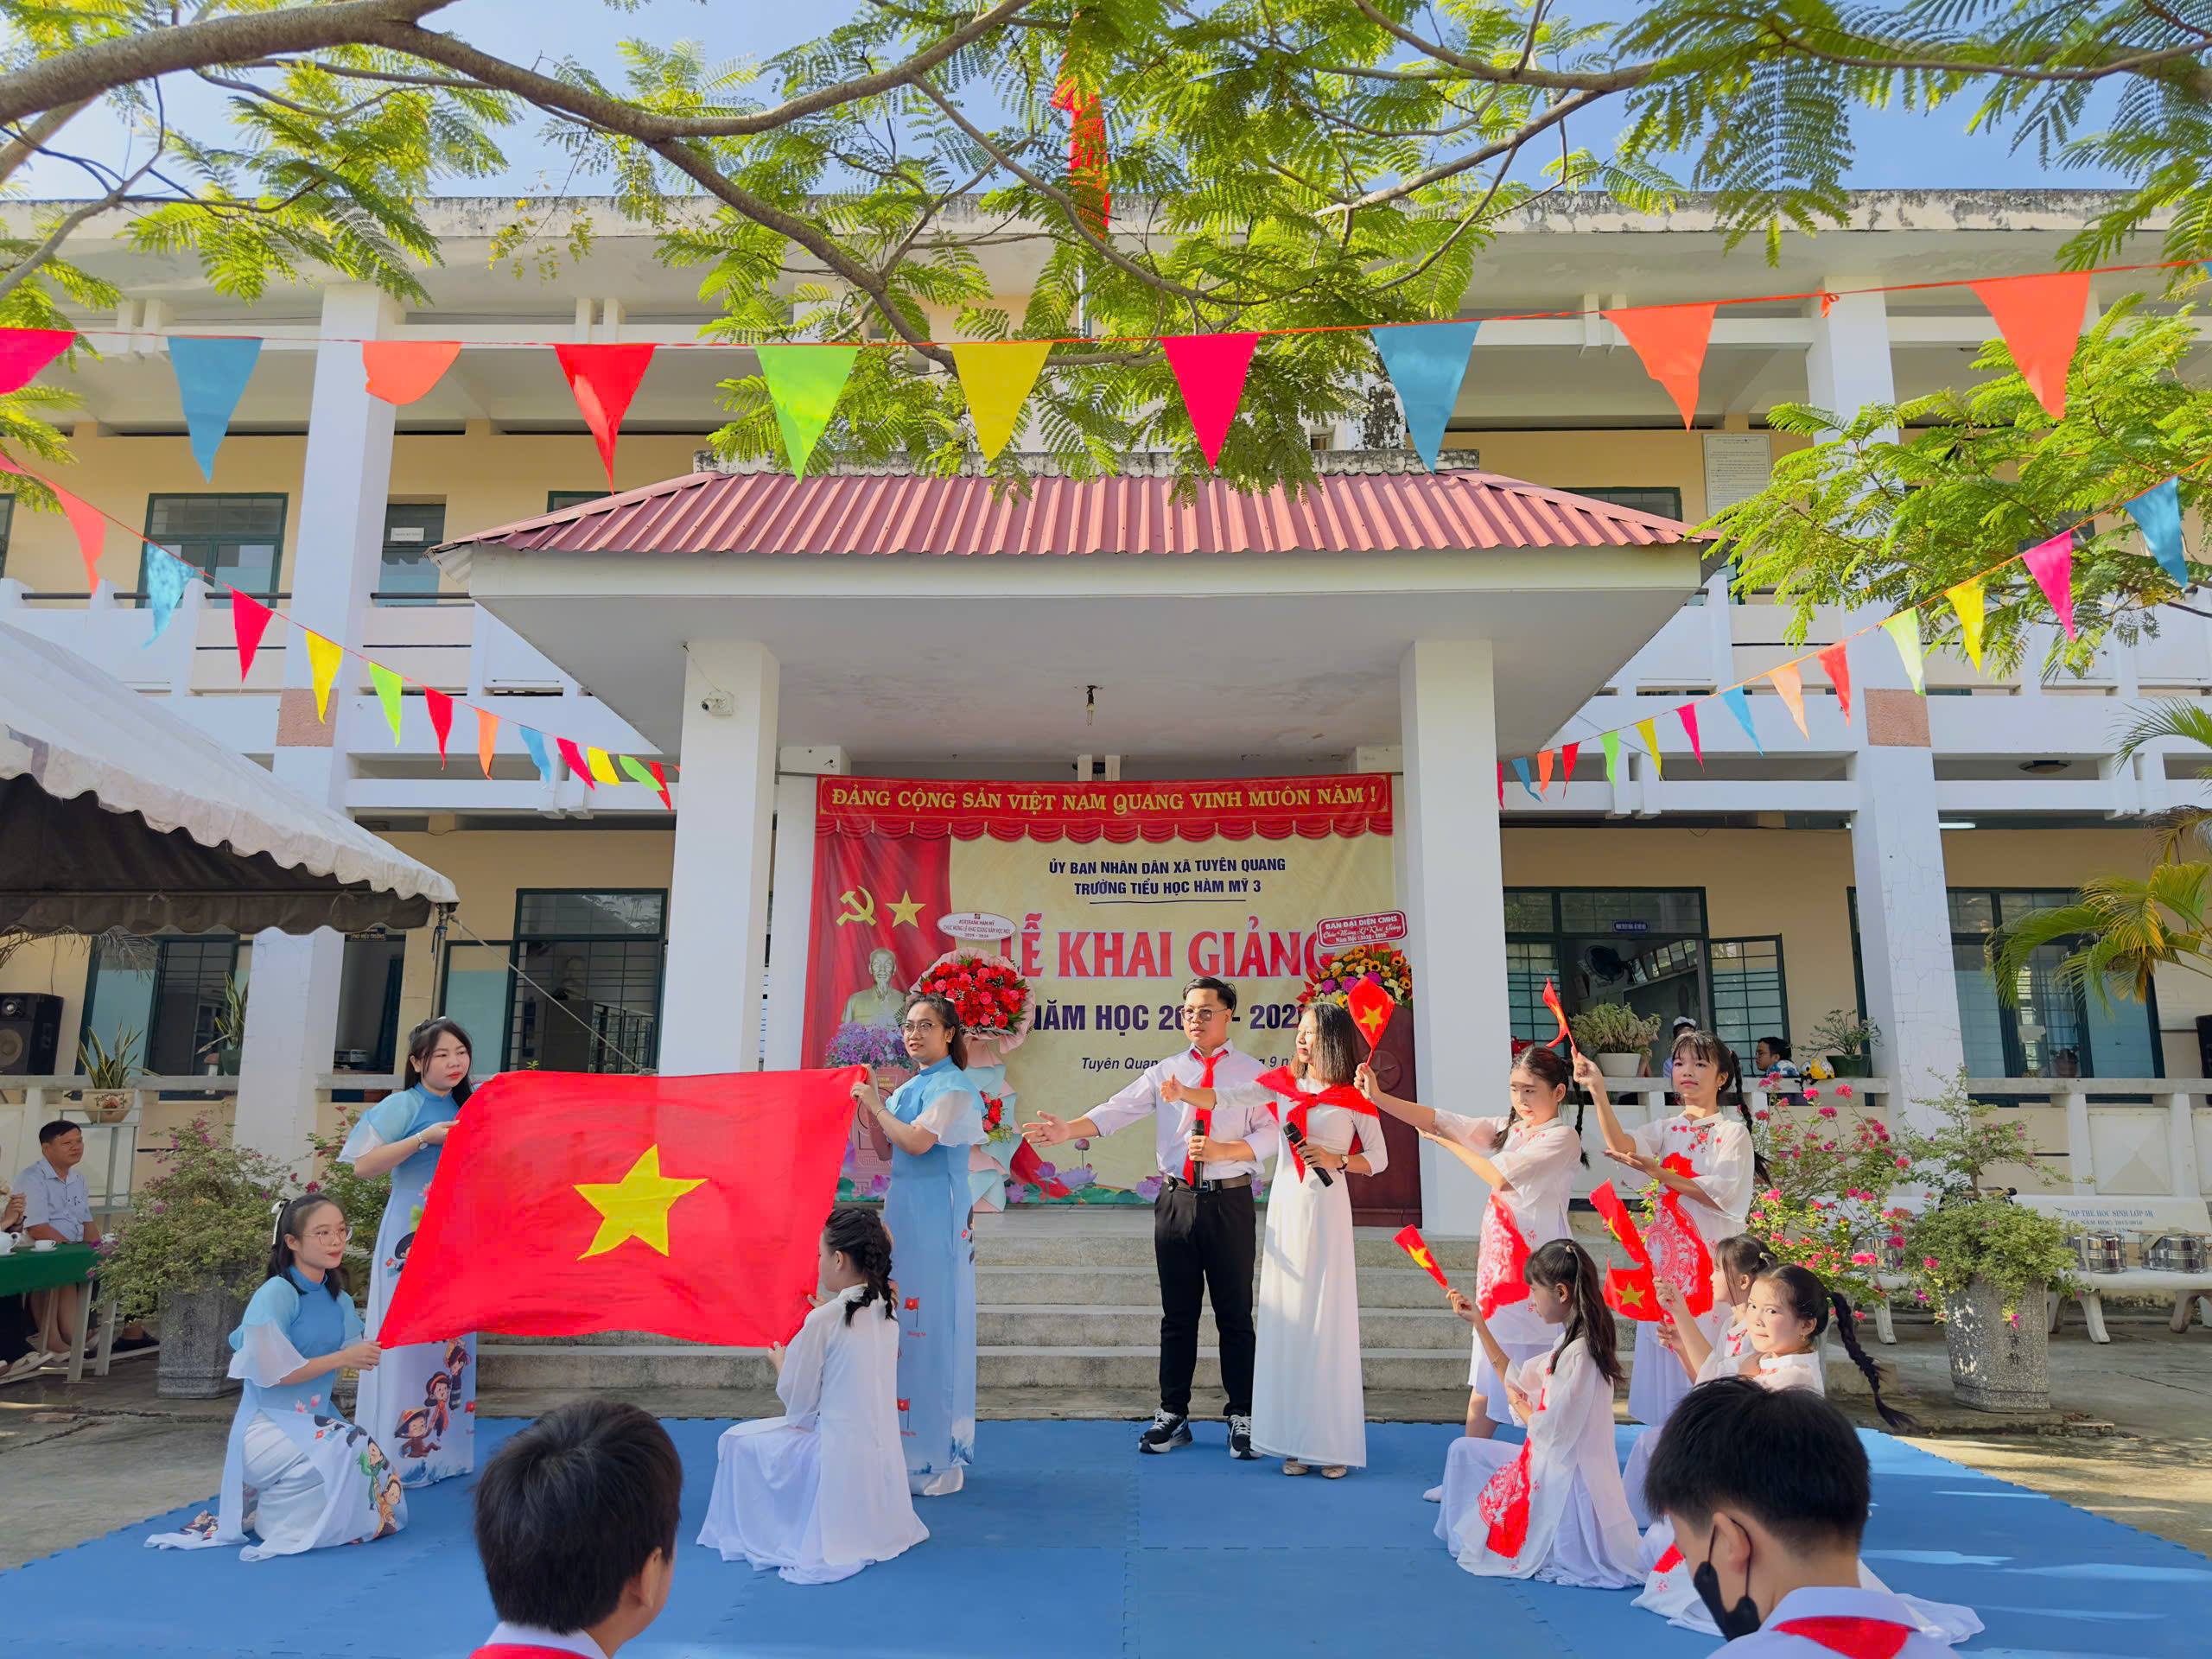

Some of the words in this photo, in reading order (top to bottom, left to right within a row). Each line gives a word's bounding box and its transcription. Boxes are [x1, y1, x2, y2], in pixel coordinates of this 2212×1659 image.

[832, 785, 891, 806] ĐẢNG
[897, 789, 957, 812] CỘNG
[963, 788, 1001, 809] SẢN
[1007, 791, 1056, 815] VIỆT
[1062, 794, 1106, 810] NAM
[1113, 793, 1183, 815] QUANG
[1190, 791, 1242, 809] VINH
[1249, 785, 1313, 807] MUÔN
[1317, 785, 1363, 804] NĂM
[1049, 858, 1065, 874] ỦY
[1070, 861, 1096, 874] BAN
[1101, 860, 1138, 874] NHÂN
[1141, 860, 1169, 874] DÂN
[1173, 859, 1192, 874] XÃ
[1194, 856, 1237, 873] TUYÊN
[1241, 858, 1286, 873] QUANG
[1074, 878, 1127, 895] TRƯỜNG
[1130, 877, 1159, 895] TIỂU
[1163, 880, 1190, 897] HỌC
[1193, 879, 1224, 893] HÀM
[1228, 877, 1249, 893] MỸ
[1253, 880, 1262, 893] 3
[1058, 931, 1173, 977] KHAI
[1095, 1004, 1148, 1036] HỌC
[1159, 1005, 1185, 1030] 20
[1249, 1003, 1301, 1029] 202
[1082, 1057, 1120, 1072] Tuyên
[1124, 1057, 1159, 1070] Quan
[1269, 1056, 1277, 1067] 9
